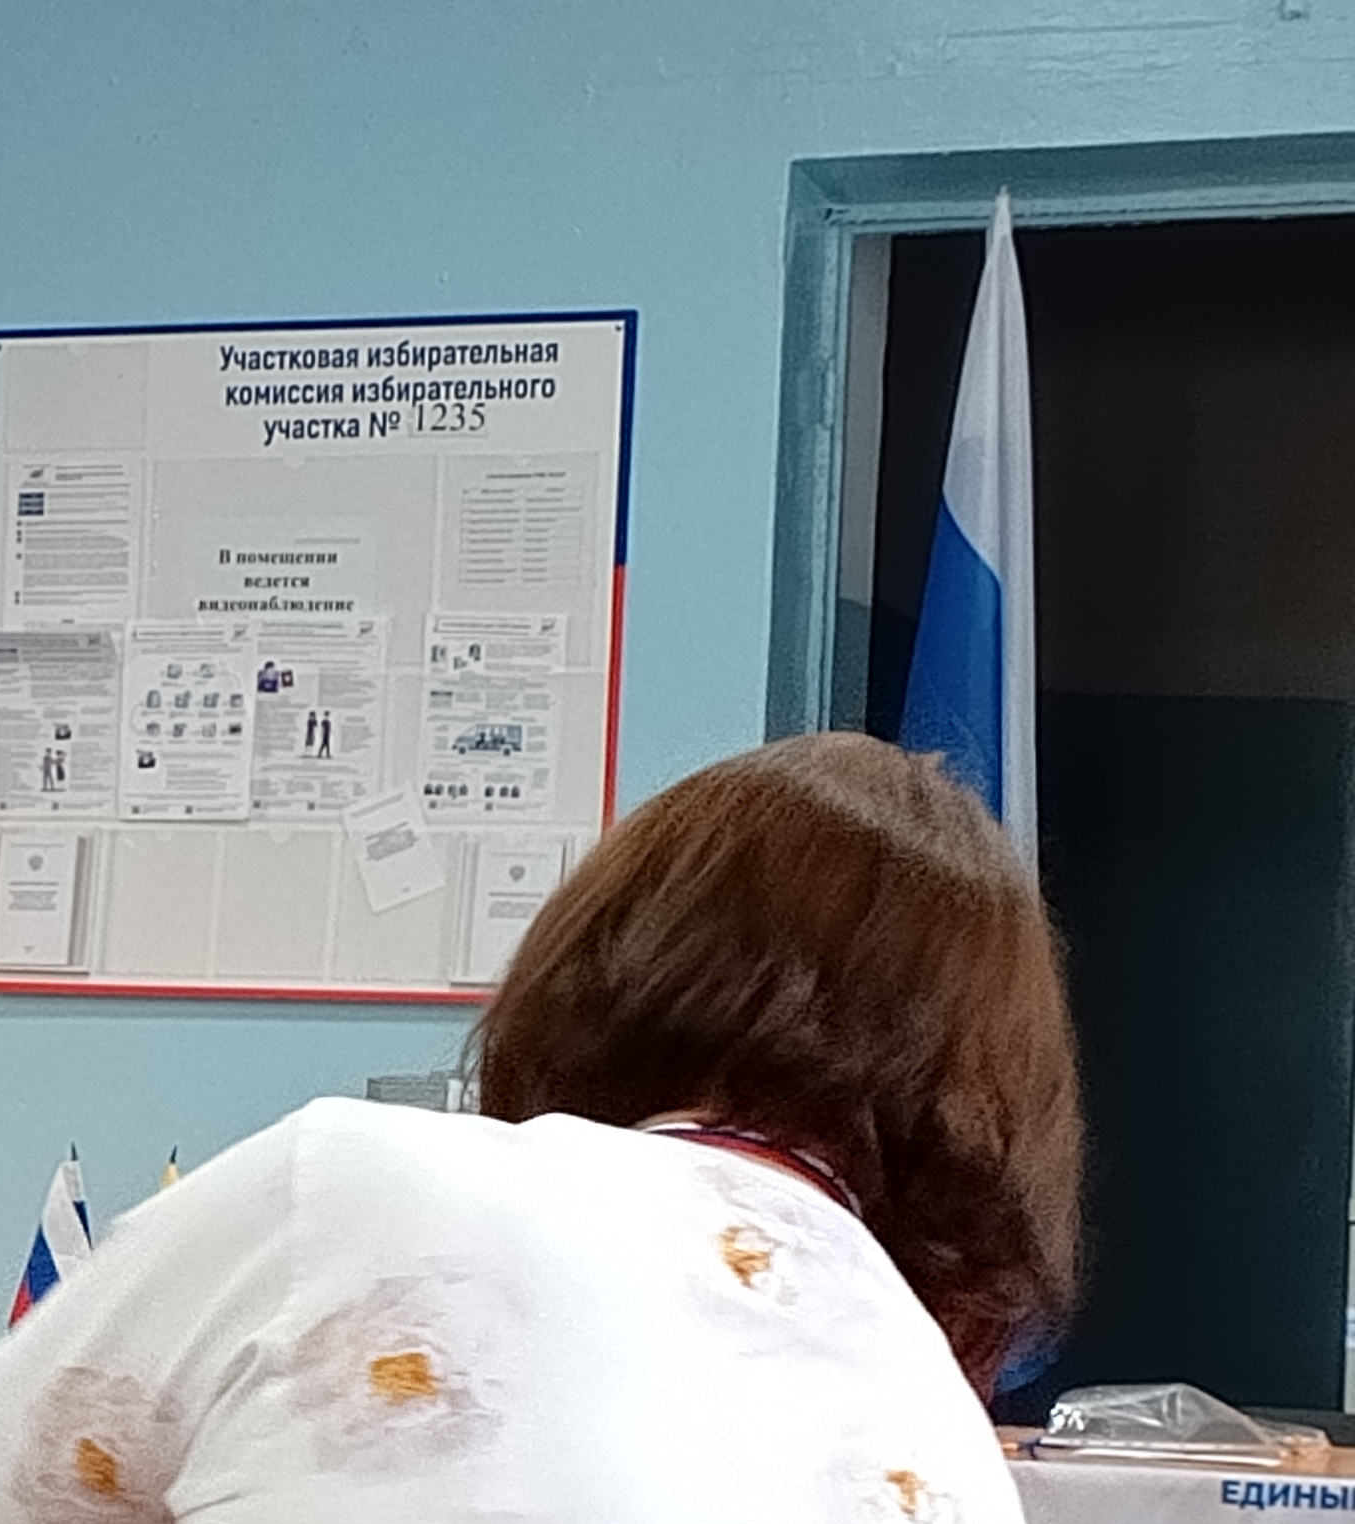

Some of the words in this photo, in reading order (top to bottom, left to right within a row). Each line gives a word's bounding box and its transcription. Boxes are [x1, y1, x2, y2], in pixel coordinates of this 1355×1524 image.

[219, 347, 359, 371] Участковая
[367, 341, 559, 370] избирательная
[225, 378, 344, 406] комиссия
[352, 374, 557, 404] избирательного
[263, 415, 361, 446] участка
[368, 411, 401, 440] №
[412, 402, 487, 433] 1235
[1221, 1480, 1355, 1510] ЕДИНЫ
